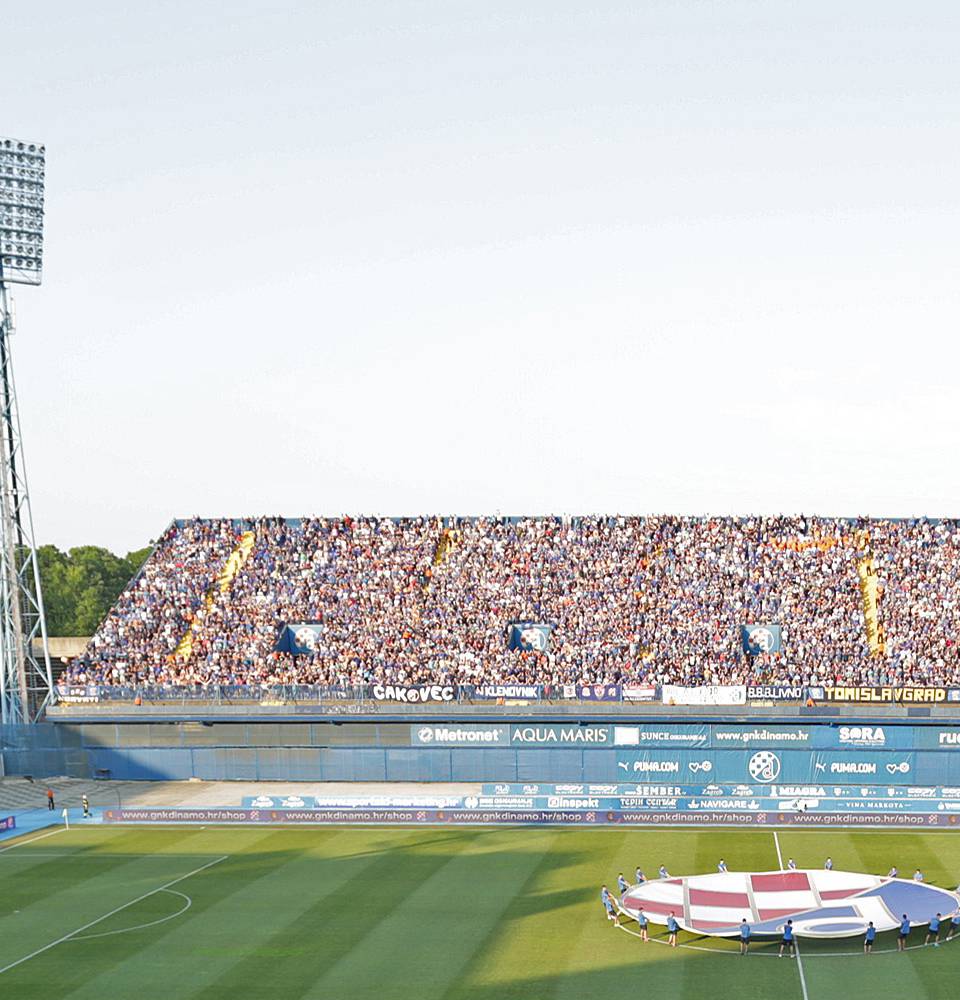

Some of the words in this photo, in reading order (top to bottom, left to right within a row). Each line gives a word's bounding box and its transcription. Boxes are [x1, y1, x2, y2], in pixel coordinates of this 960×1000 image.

[824, 687, 946, 701] TOMISLAVGRAD
[435, 728, 500, 742] Metronet
[512, 728, 558, 742] AQUA
[560, 728, 607, 742] MARIS
[716, 729, 809, 742] www.gnkdinamo.hr
[633, 761, 679, 772] PUMA.COM
[830, 762, 876, 773] PUMA.COM
[636, 785, 682, 796] ŠEMBER
[700, 800, 747, 808] NAVIGARE
[122, 811, 246, 821] www.gnkdinamo.hr/shop
[286, 811, 413, 821] www.gnkdinamo.hr/shop
[453, 811, 582, 822] www.gnkdinamo.hr/shop
[623, 812, 753, 823] www.gnkdinamo.hr/shop
[793, 813, 924, 825] www.gnkdinamo.hr/shop
